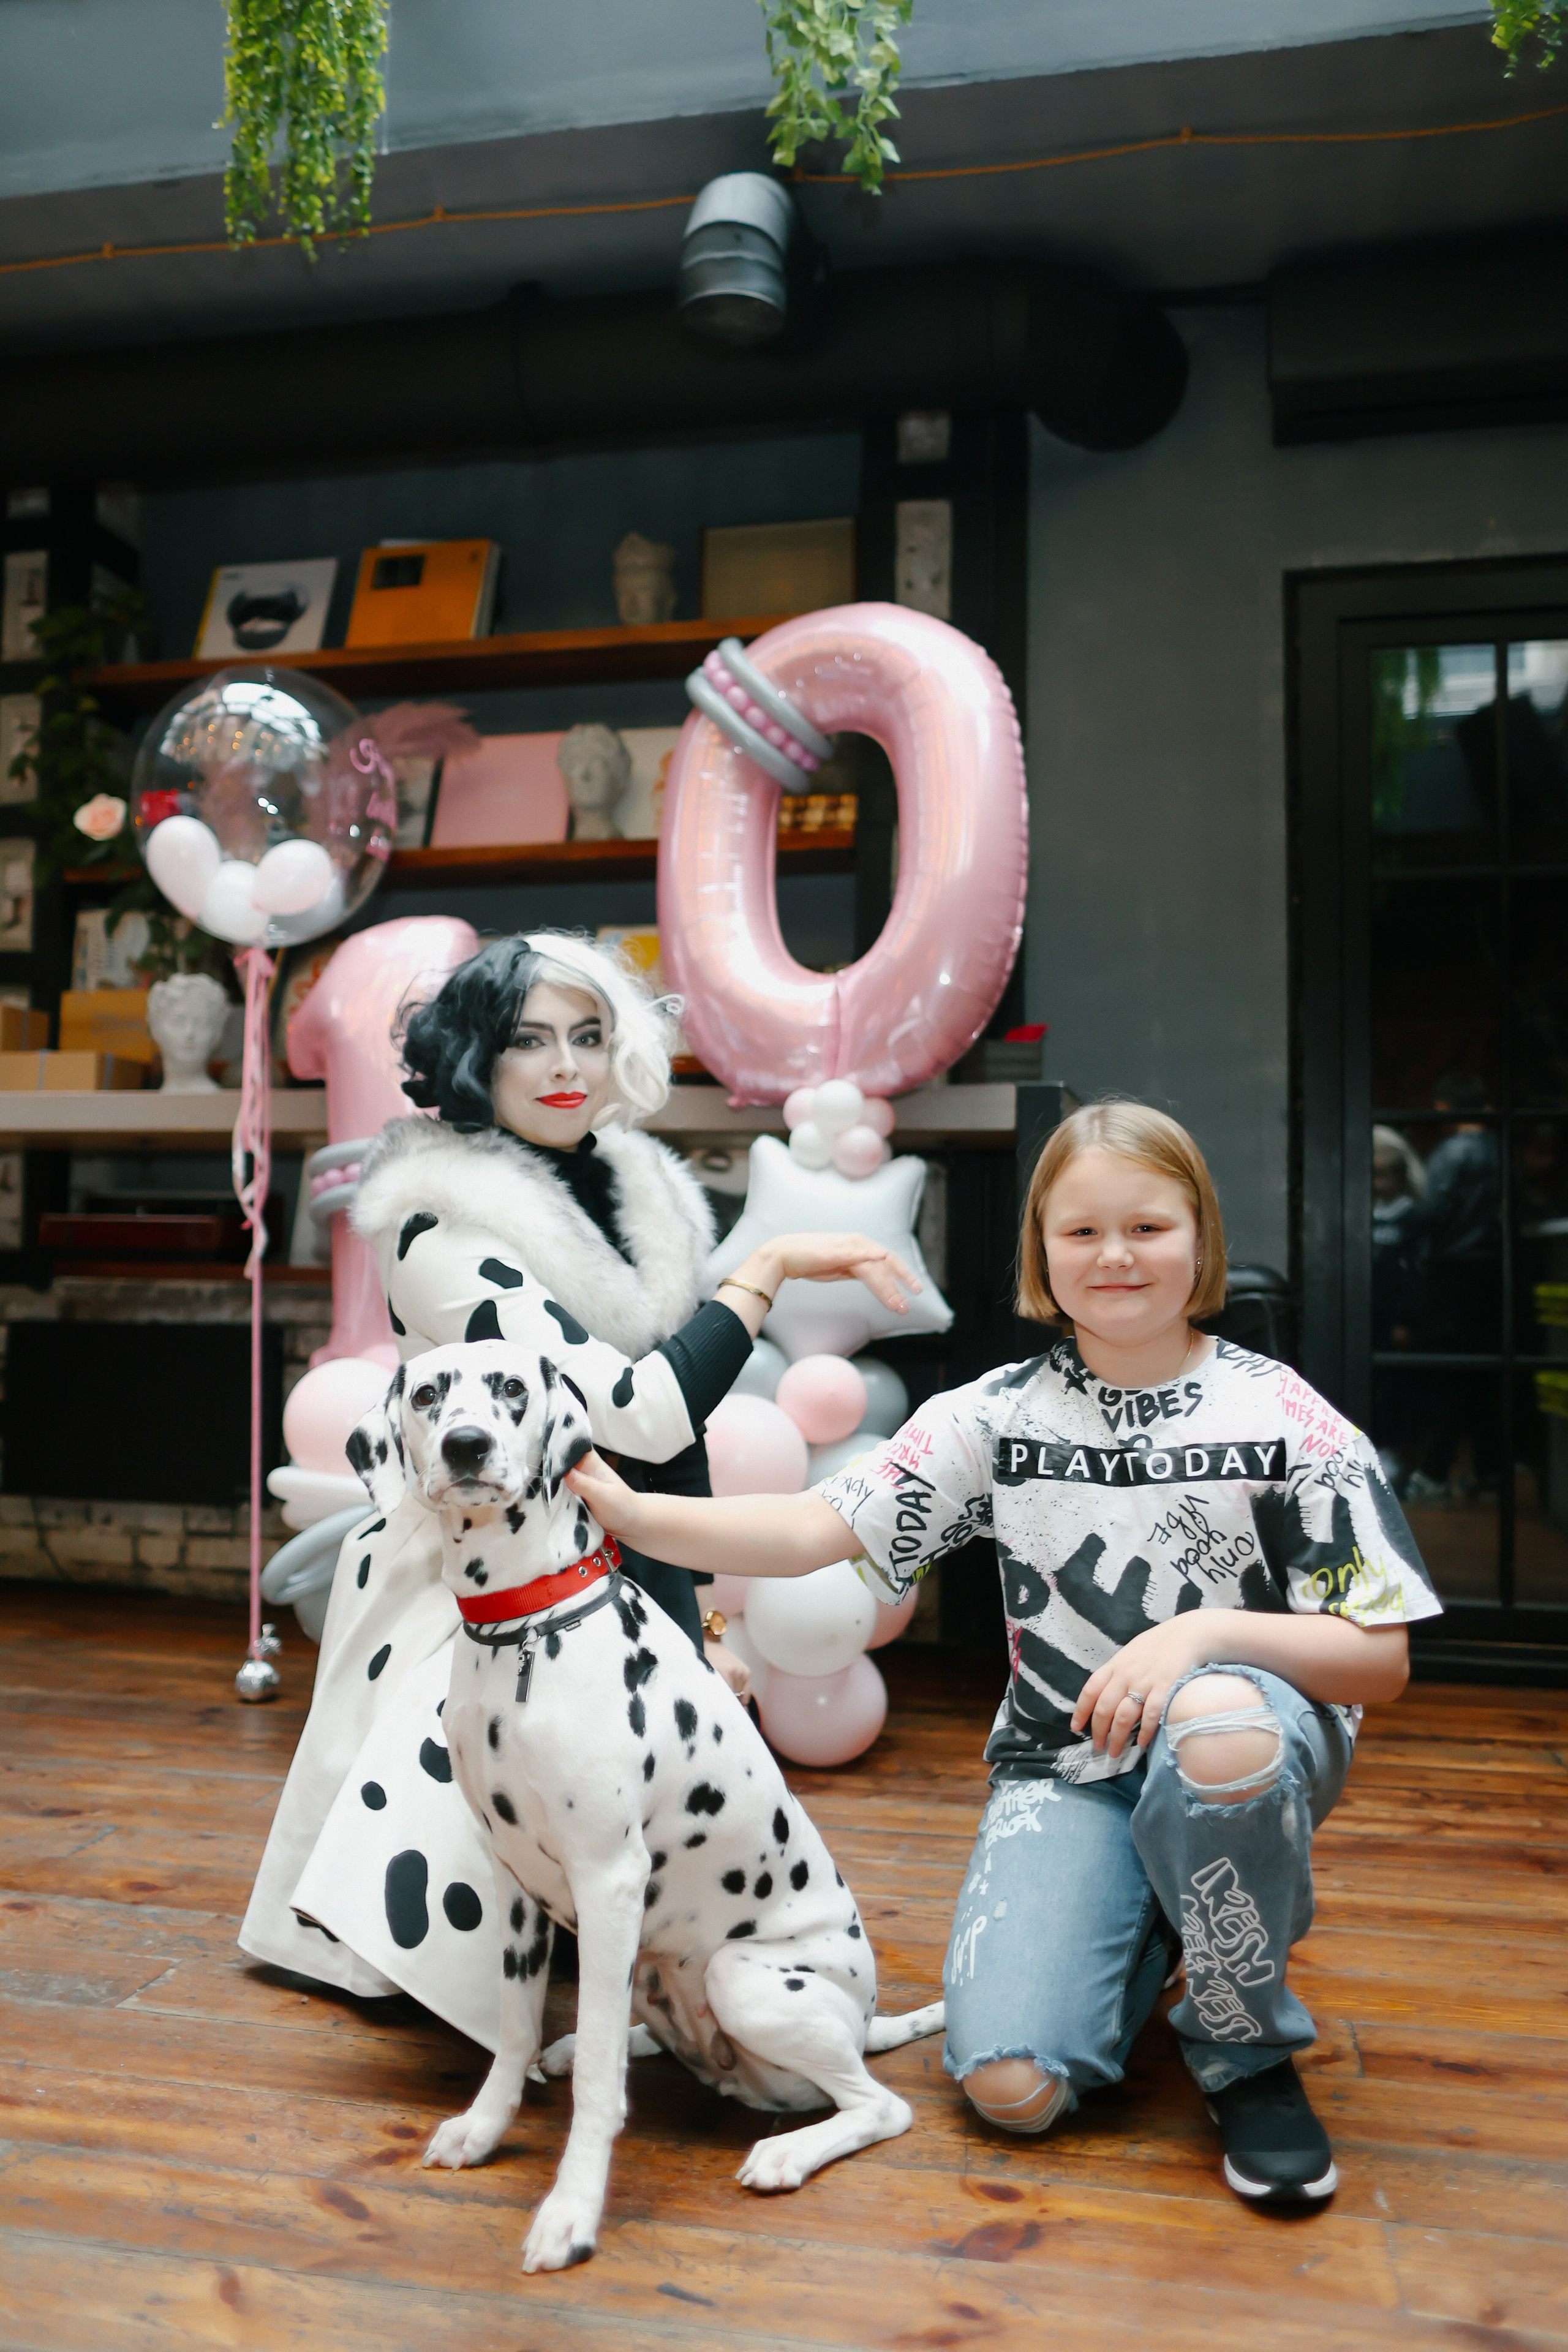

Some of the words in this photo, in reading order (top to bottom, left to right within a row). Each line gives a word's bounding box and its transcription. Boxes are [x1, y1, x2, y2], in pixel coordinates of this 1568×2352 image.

[1101, 1382, 1203, 1432] VIBES
[1011, 1444, 1277, 1482] PLAYTODAY
[889, 1461, 936, 1578] TODAY
